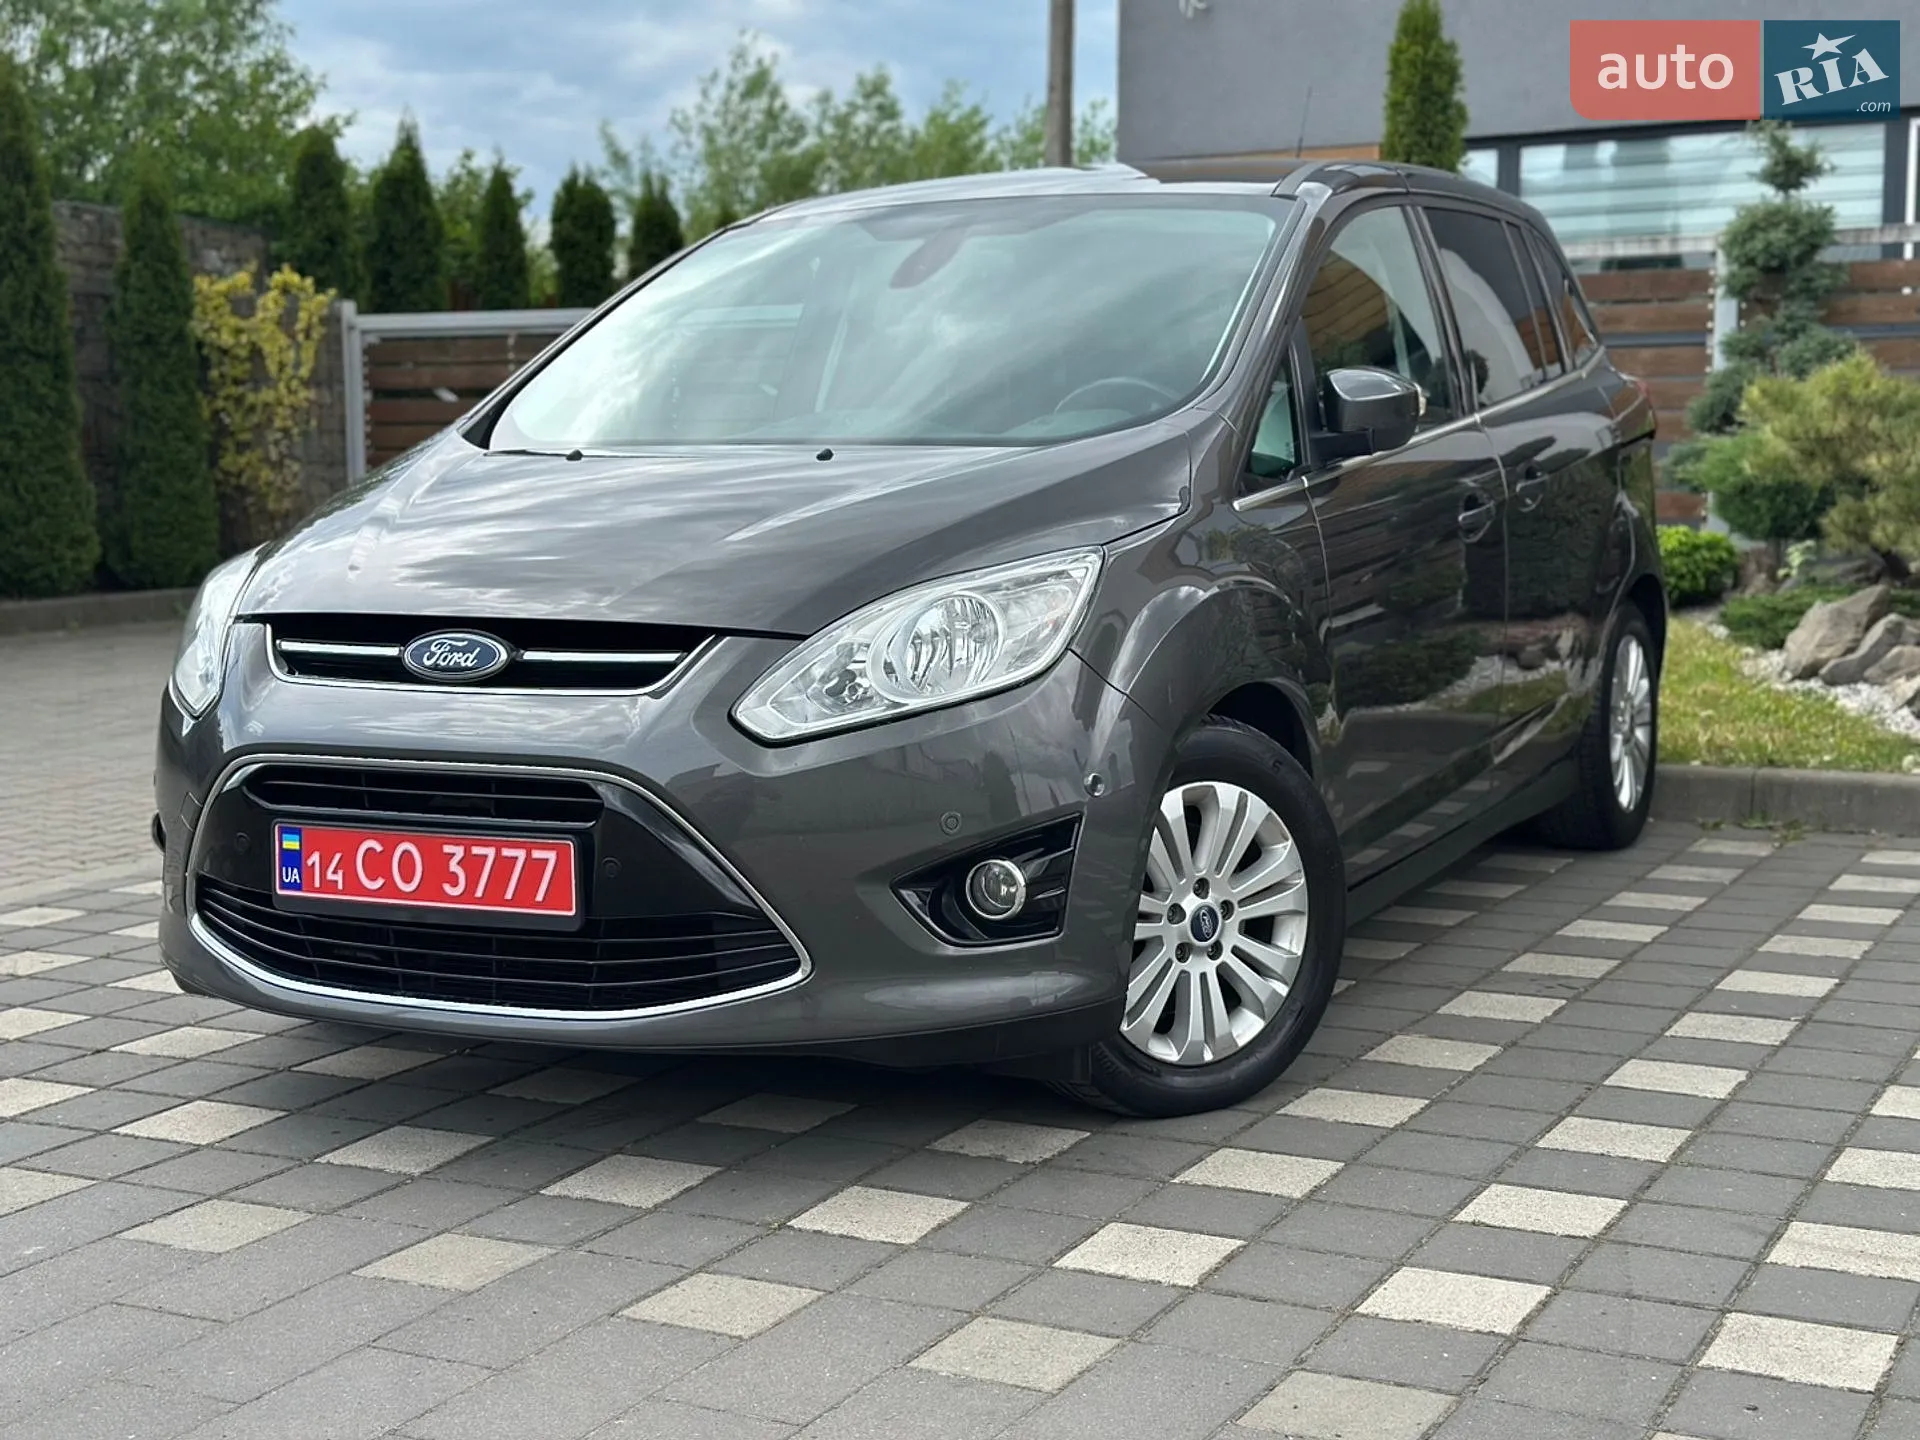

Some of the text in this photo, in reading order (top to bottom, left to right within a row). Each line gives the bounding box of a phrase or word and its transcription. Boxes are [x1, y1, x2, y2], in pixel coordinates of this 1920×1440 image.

[422, 639, 481, 667] Ford
[282, 866, 301, 884] UA
[306, 839, 558, 902] 14 CO 3777
